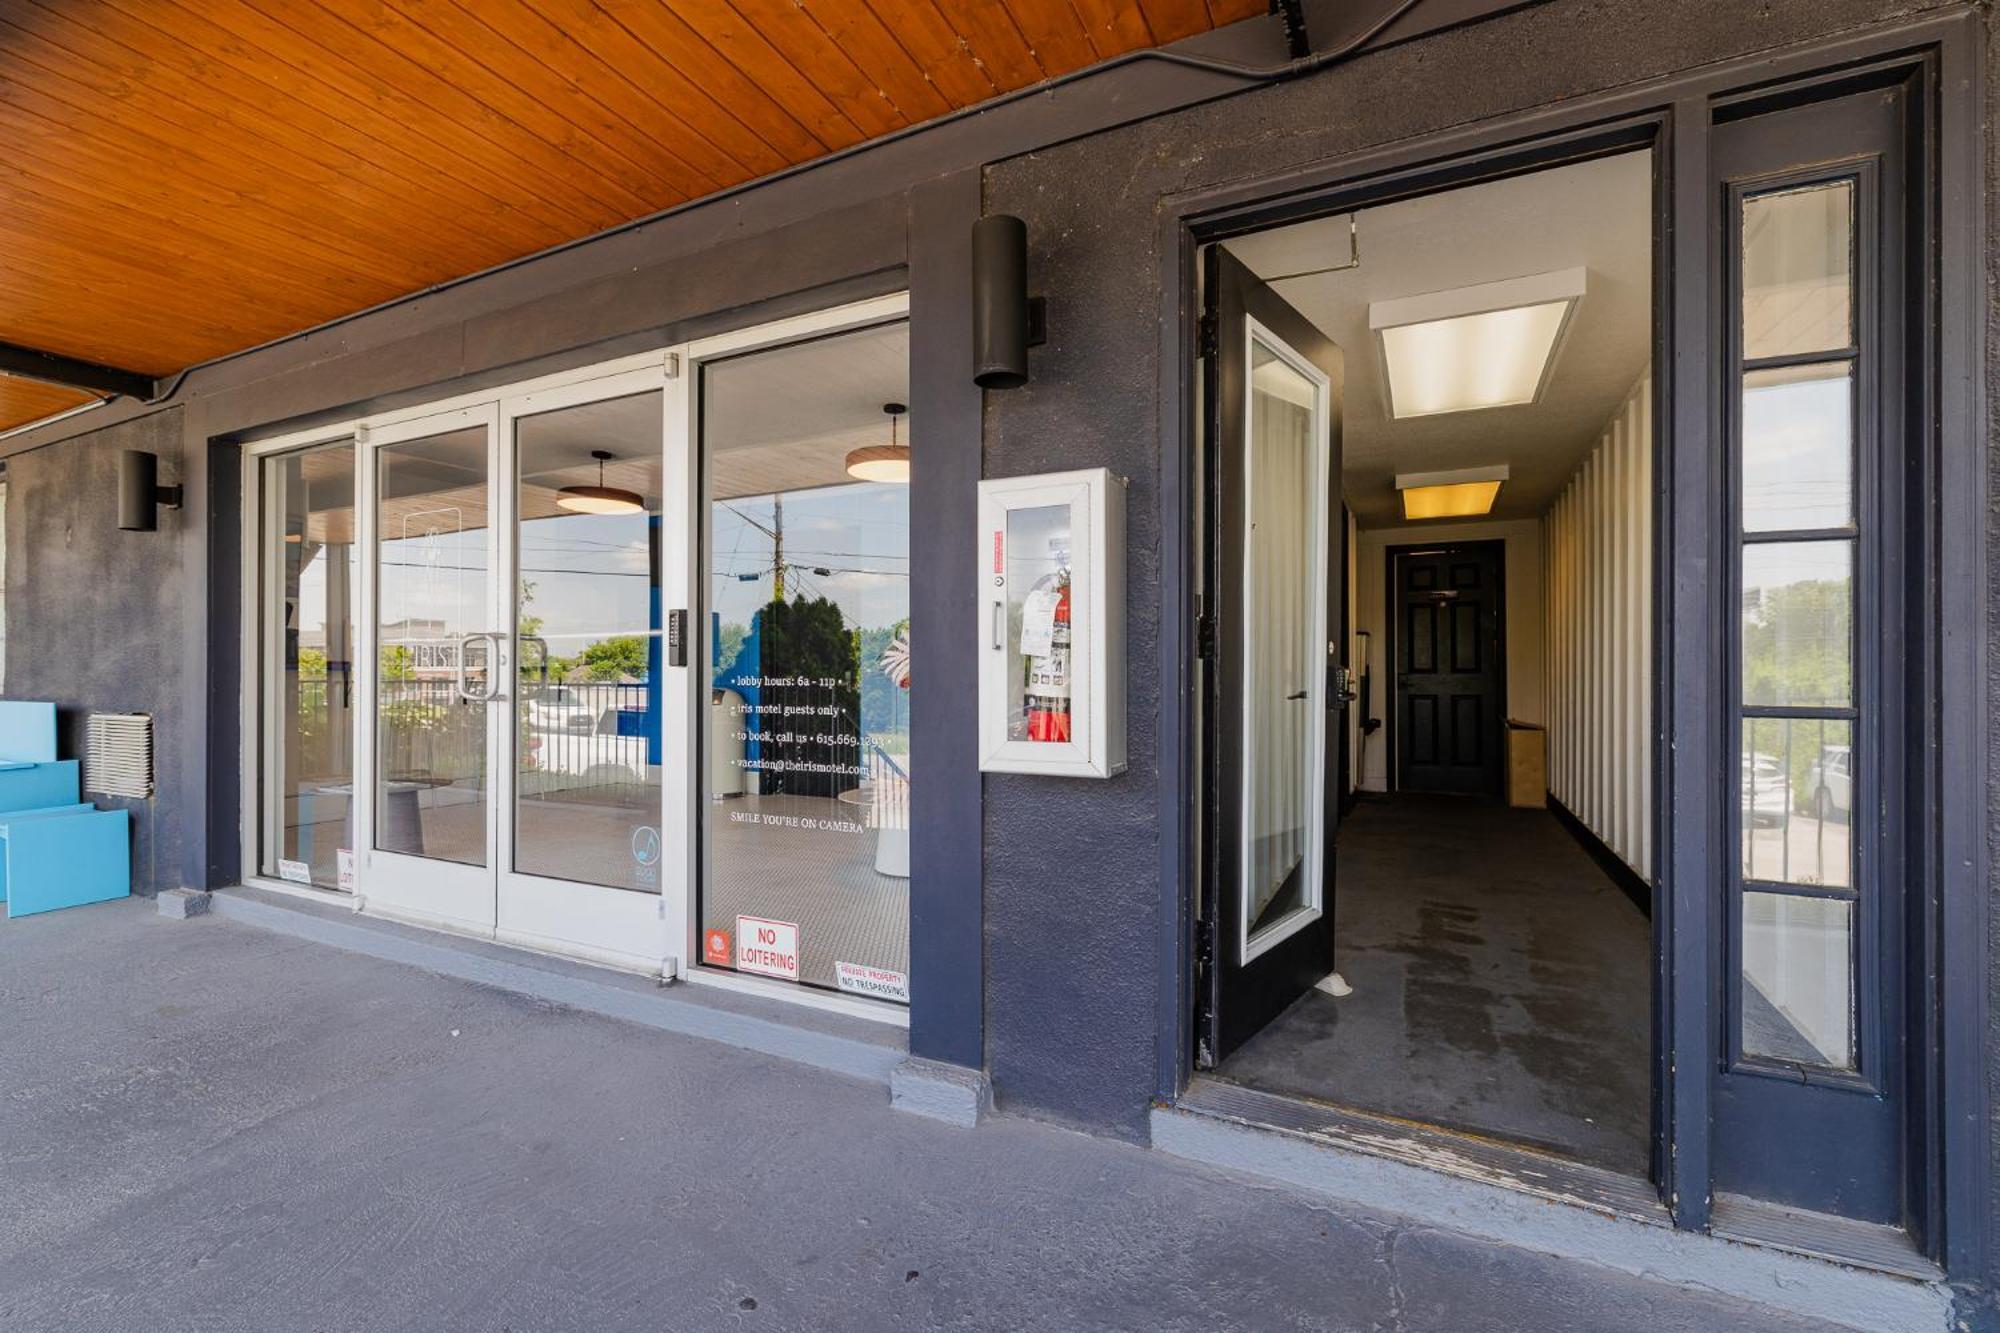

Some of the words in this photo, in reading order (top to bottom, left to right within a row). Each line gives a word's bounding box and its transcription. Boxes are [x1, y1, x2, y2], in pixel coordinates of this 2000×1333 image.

[737, 675, 761, 688] lobby
[764, 675, 795, 686] hours:
[797, 676, 810, 686] 6a
[819, 677, 836, 689] 11p
[737, 704, 753, 713] iris
[755, 704, 782, 714] motel
[783, 705, 816, 717] guests
[817, 705, 840, 718] only
[736, 731, 746, 741] to
[748, 731, 774, 743] book,
[776, 732, 793, 742] call
[796, 734, 808, 743] us
[737, 757, 870, 776] vacation@theirismotel.com
[730, 811, 761, 823] SMILE
[762, 815, 799, 828] YOU'RE
[800, 817, 817, 829] ON
[819, 819, 864, 834] CAMERA
[758, 927, 776, 945] NO
[740, 947, 795, 971] LOITERING
[842, 976, 854, 986] NO
[856, 979, 905, 997] TRESPASSING
